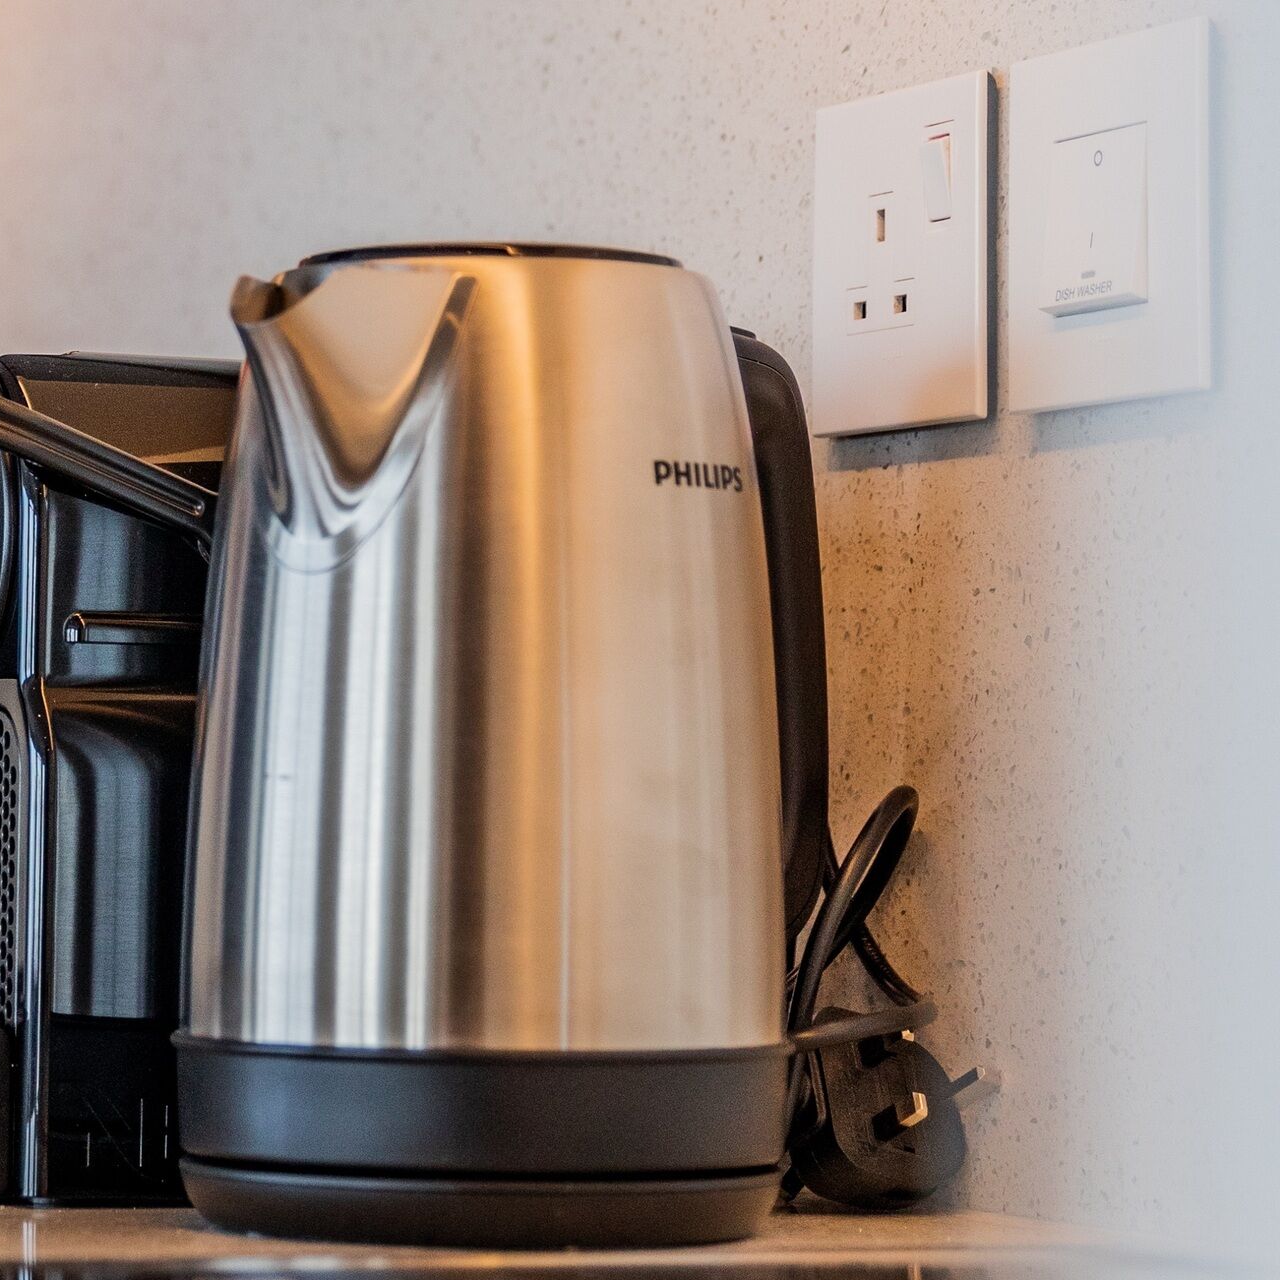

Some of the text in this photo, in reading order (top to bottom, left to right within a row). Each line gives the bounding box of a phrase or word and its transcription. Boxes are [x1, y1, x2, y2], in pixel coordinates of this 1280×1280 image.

[1055, 280, 1112, 301] DISH WASHER
[653, 460, 743, 492] PHILIPS
